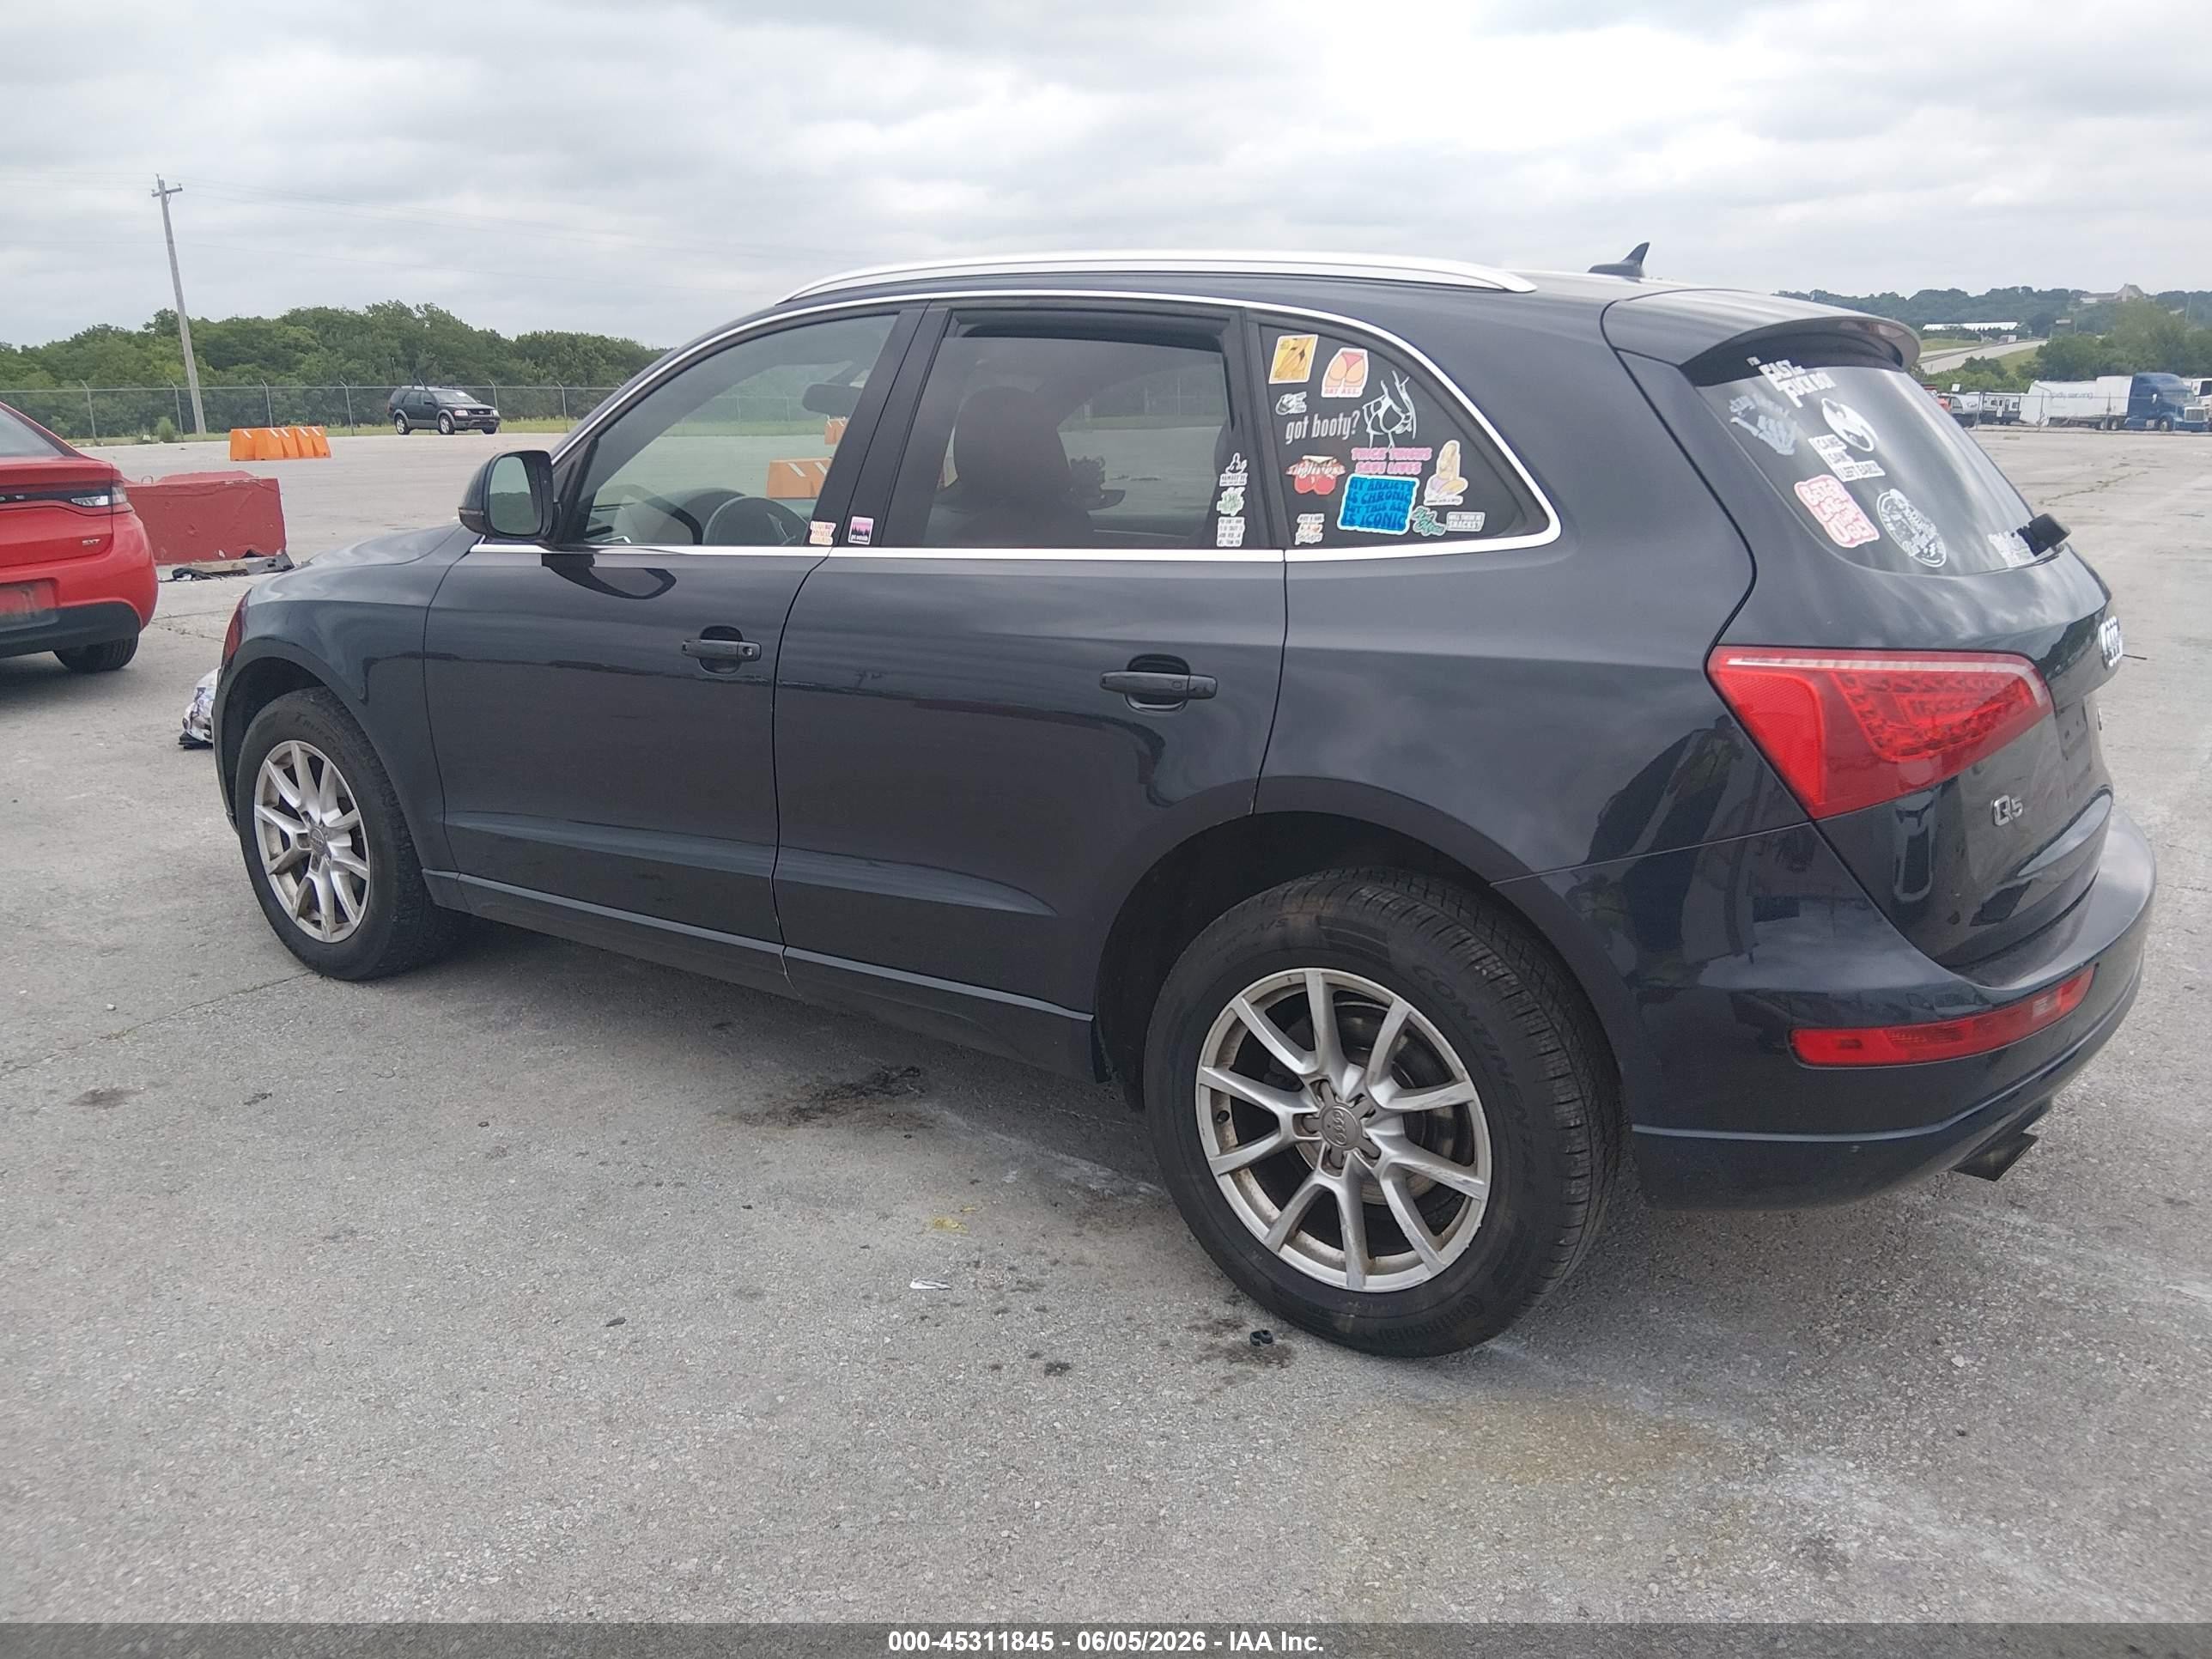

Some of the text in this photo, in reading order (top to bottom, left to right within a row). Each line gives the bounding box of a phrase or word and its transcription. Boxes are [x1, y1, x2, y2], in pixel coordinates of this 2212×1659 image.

[1285, 410, 1361, 445] got booty?
[1387, 462, 1422, 475] LIVES
[1351, 478, 1415, 491] MY ANXIETY
[1346, 490, 1359, 503] IS
[1360, 489, 1412, 505] CHRONIC
[1364, 501, 1388, 514] THIS
[1343, 512, 1406, 530] IS ICONIC
[1992, 795, 2023, 826] Q5
